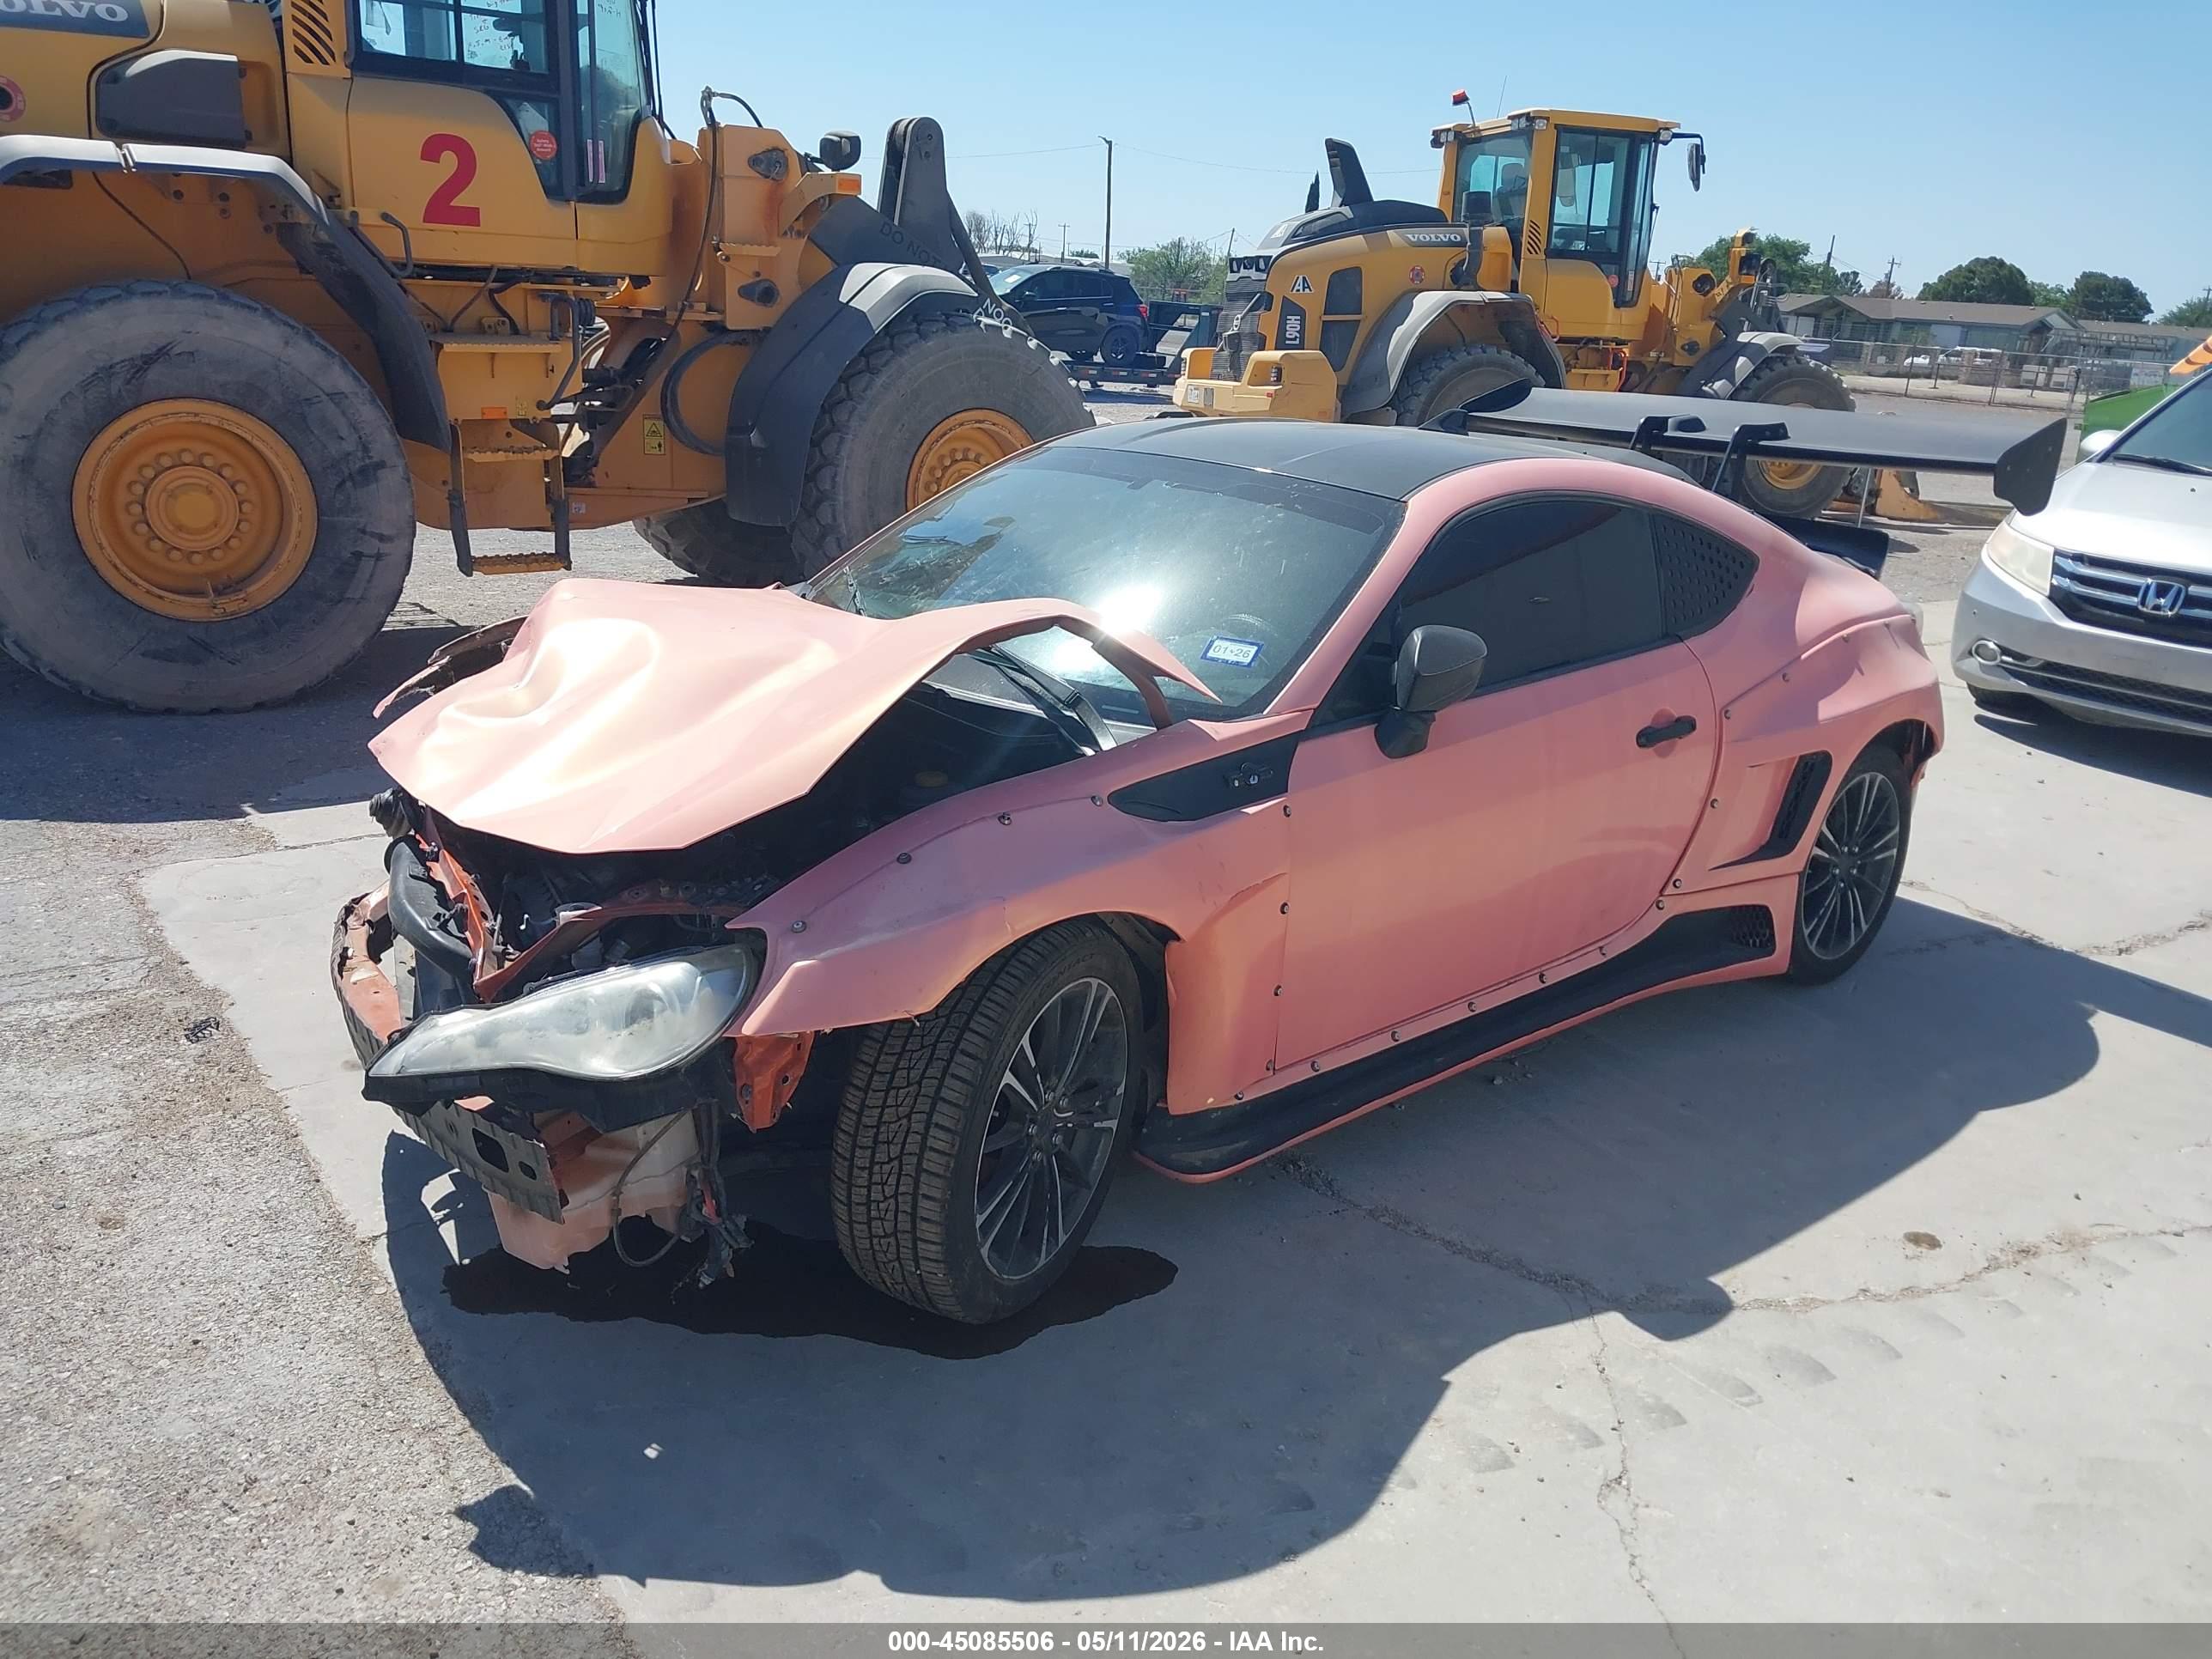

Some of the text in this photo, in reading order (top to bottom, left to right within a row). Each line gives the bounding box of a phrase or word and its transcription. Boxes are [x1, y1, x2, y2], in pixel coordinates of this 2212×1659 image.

[420, 133, 481, 227] 2
[880, 222, 903, 244] DO
[1406, 233, 1462, 242] VOLVO
[1285, 315, 1301, 345] L90H
